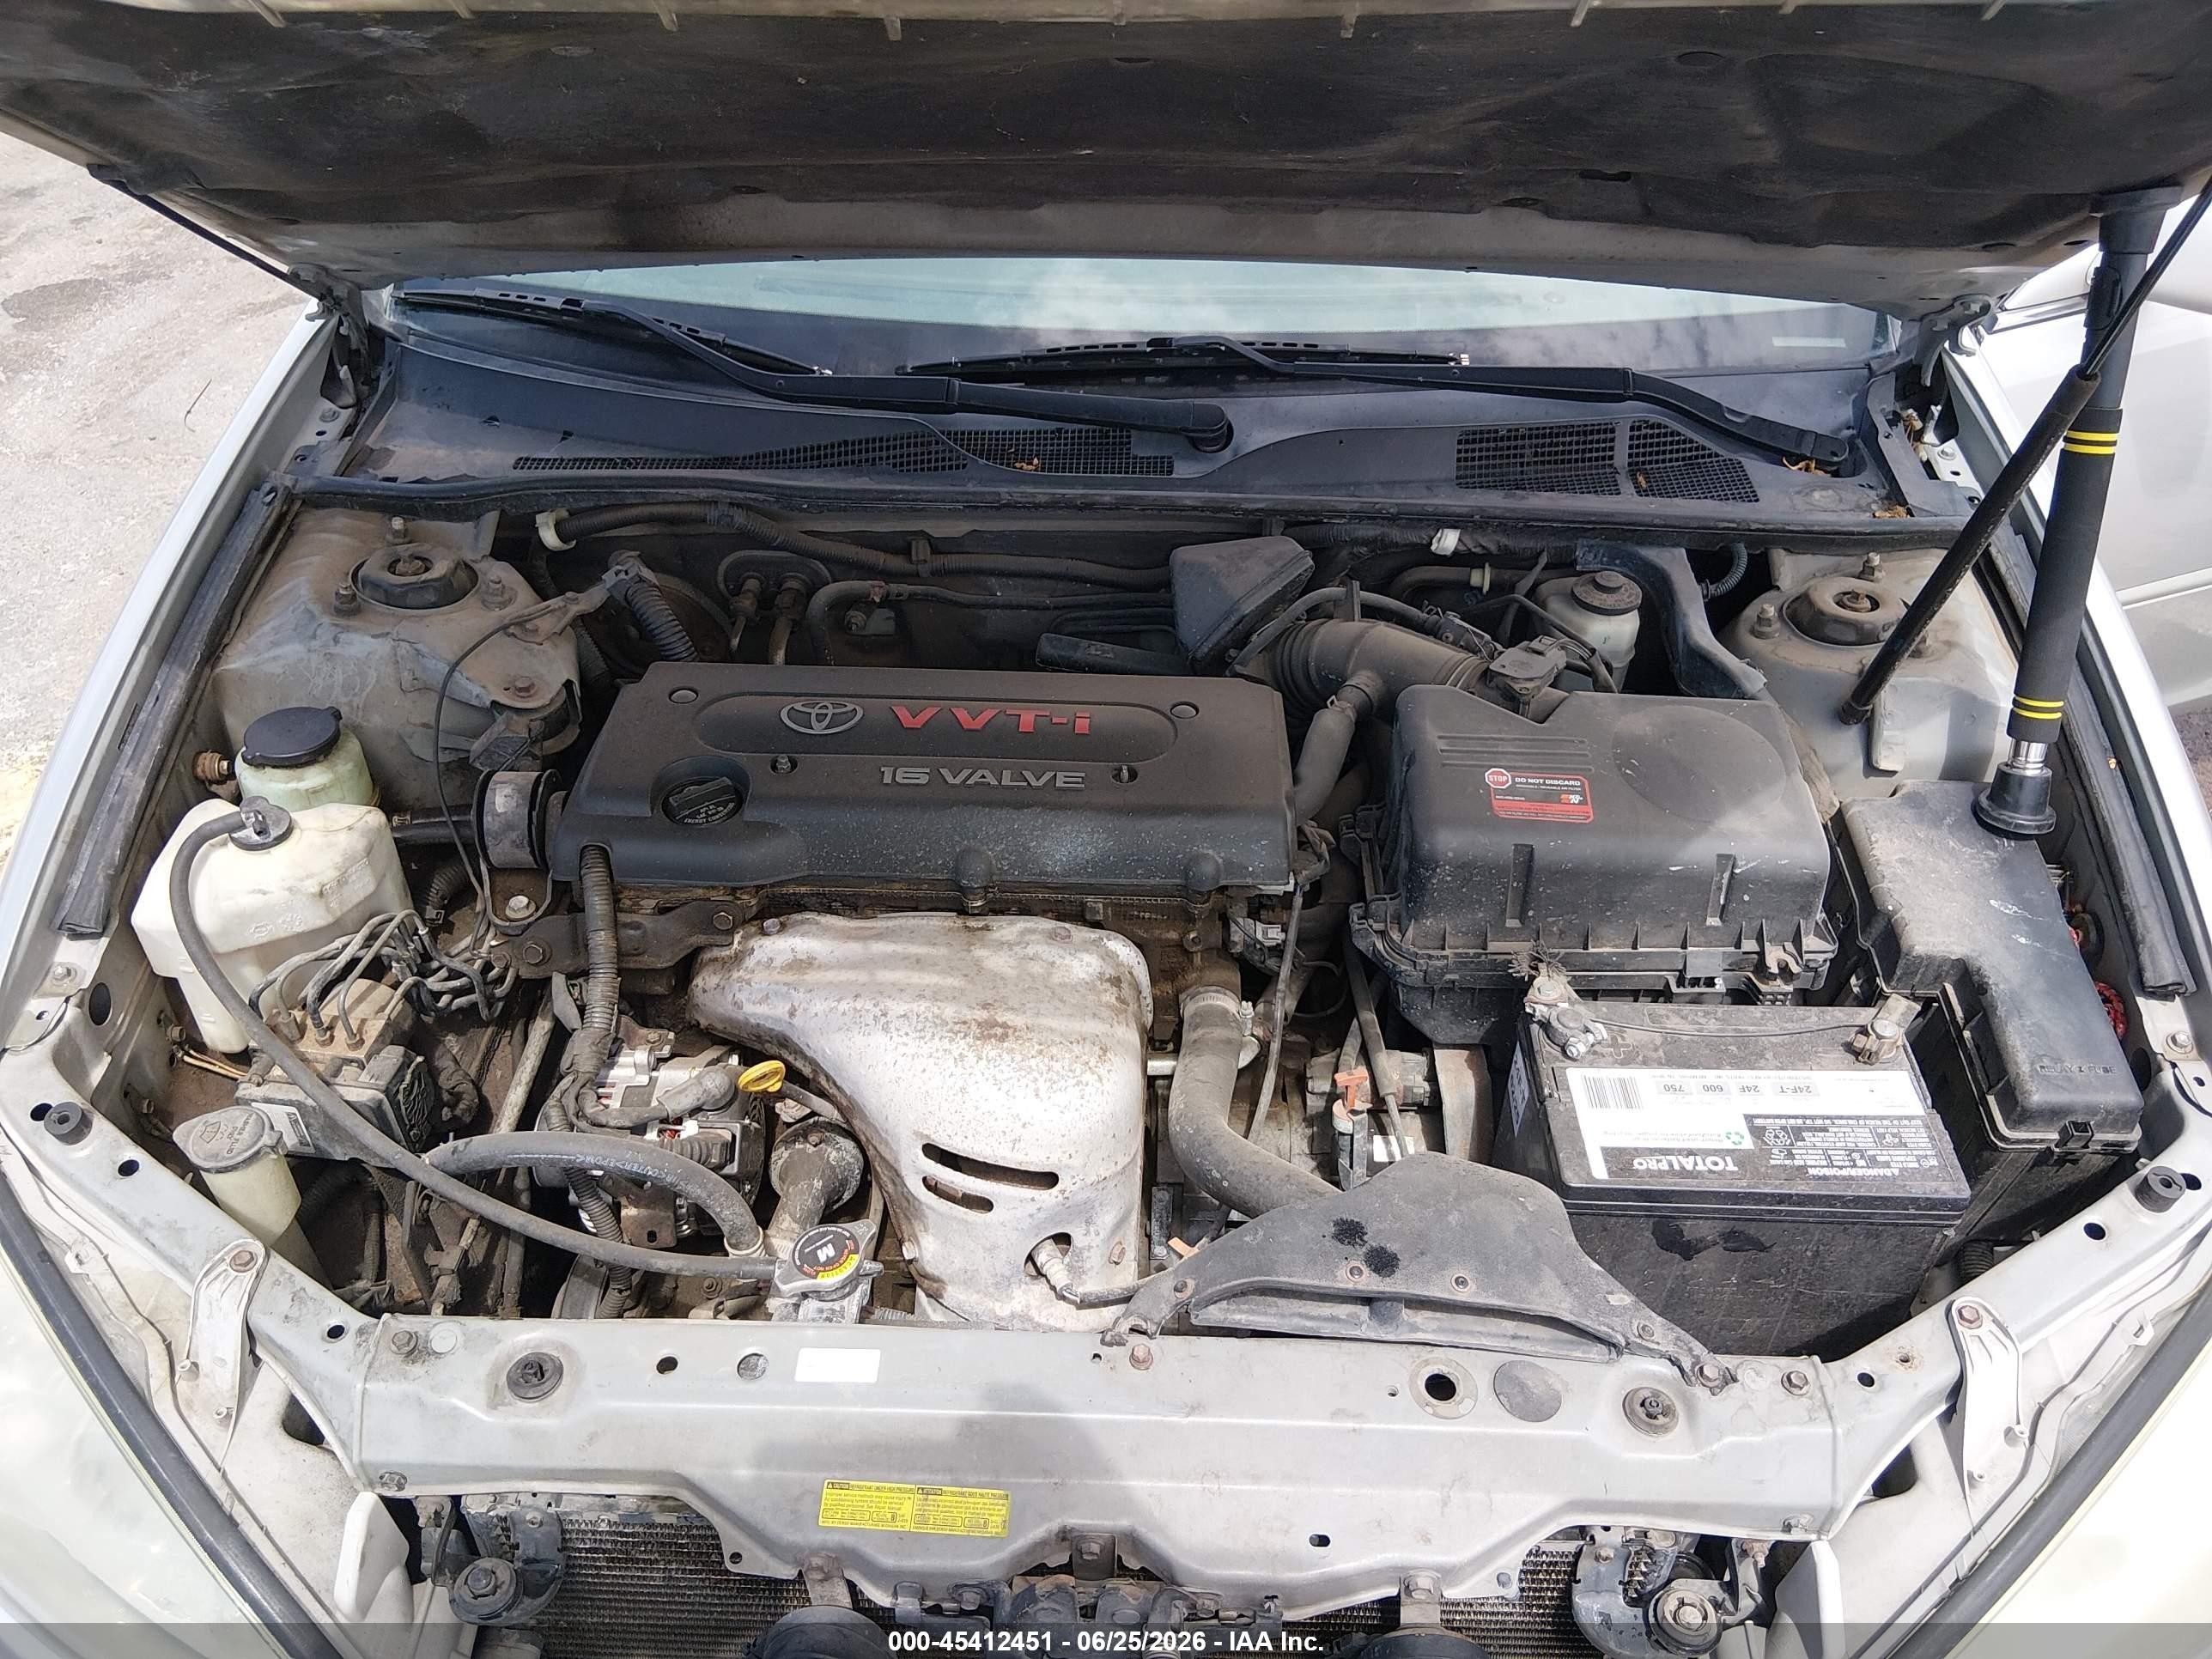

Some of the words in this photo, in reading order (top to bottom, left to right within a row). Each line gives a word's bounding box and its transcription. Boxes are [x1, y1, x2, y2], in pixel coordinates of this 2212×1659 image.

[891, 706, 1091, 734] VVT-i
[880, 766, 930, 785] 16
[939, 768, 1085, 789] VALVE
[2039, 1064, 2073, 1073] RELAY
[2087, 1065, 2117, 1074] FUSE
[1663, 1084, 1685, 1093] 750
[1703, 1084, 1724, 1093] 600
[1739, 1085, 1760, 1093] 24F
[1779, 1085, 1812, 1094] 24F-T
[1632, 1155, 1739, 1171] TOTALPRO
